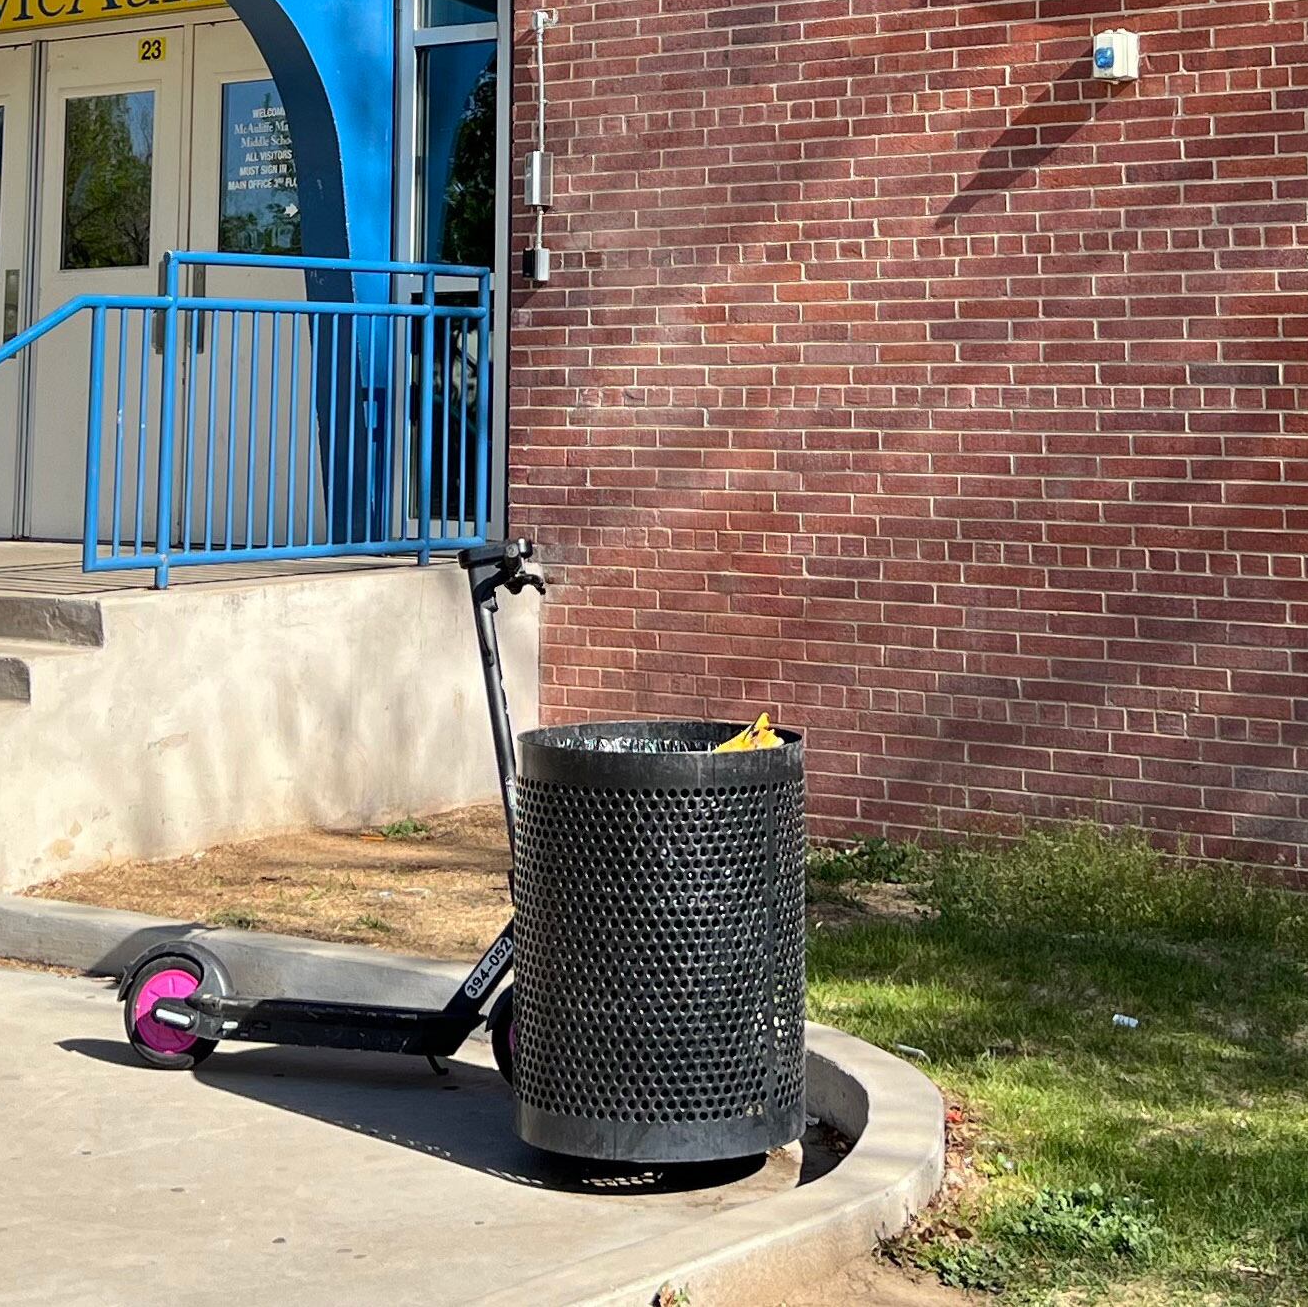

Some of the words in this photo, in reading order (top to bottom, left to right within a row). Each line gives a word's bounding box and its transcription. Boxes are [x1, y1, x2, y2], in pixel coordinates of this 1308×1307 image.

[141, 39, 162, 61] 23
[252, 106, 286, 119] WELCOM
[270, 134, 293, 146] Scho
[245, 152, 259, 163] ALL
[260, 149, 293, 161] VISITORS
[239, 165, 259, 177] MUST
[260, 164, 278, 175] SIGN
[228, 180, 247, 191] MAIN
[248, 178, 273, 190] OFFICE
[467, 938, 512, 996] 394-052
